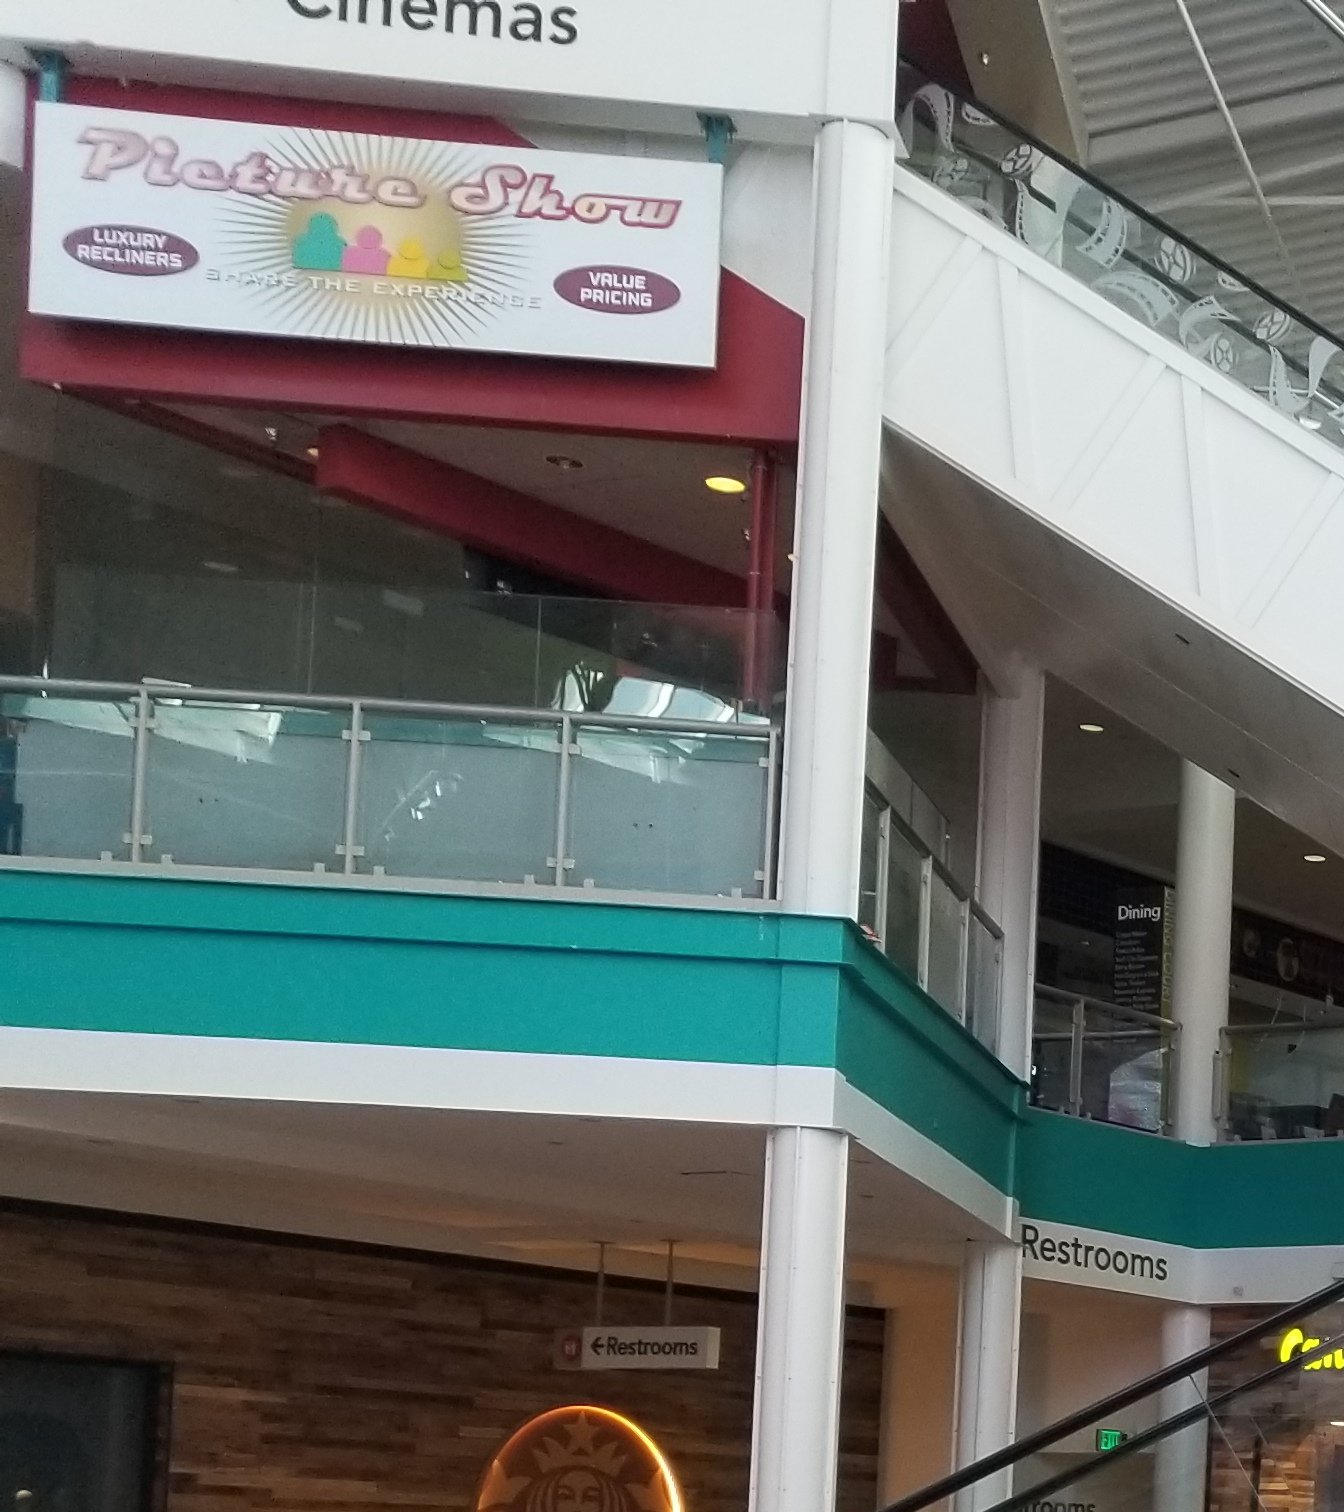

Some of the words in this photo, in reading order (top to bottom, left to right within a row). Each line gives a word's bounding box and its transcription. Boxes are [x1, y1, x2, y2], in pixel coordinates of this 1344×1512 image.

[77, 127, 427, 208] Picture
[450, 163, 683, 229] Show
[92, 227, 168, 249] LUXURY
[76, 245, 183, 269] RECLINERS
[588, 271, 647, 290] VALUE
[307, 274, 360, 293] THE
[372, 280, 542, 310] EXPERIENCE
[579, 287, 653, 308] PRICING
[1117, 904, 1161, 922] Dining
[1021, 1224, 1168, 1281] Restrooms
[606, 1336, 698, 1356] Restrooms
